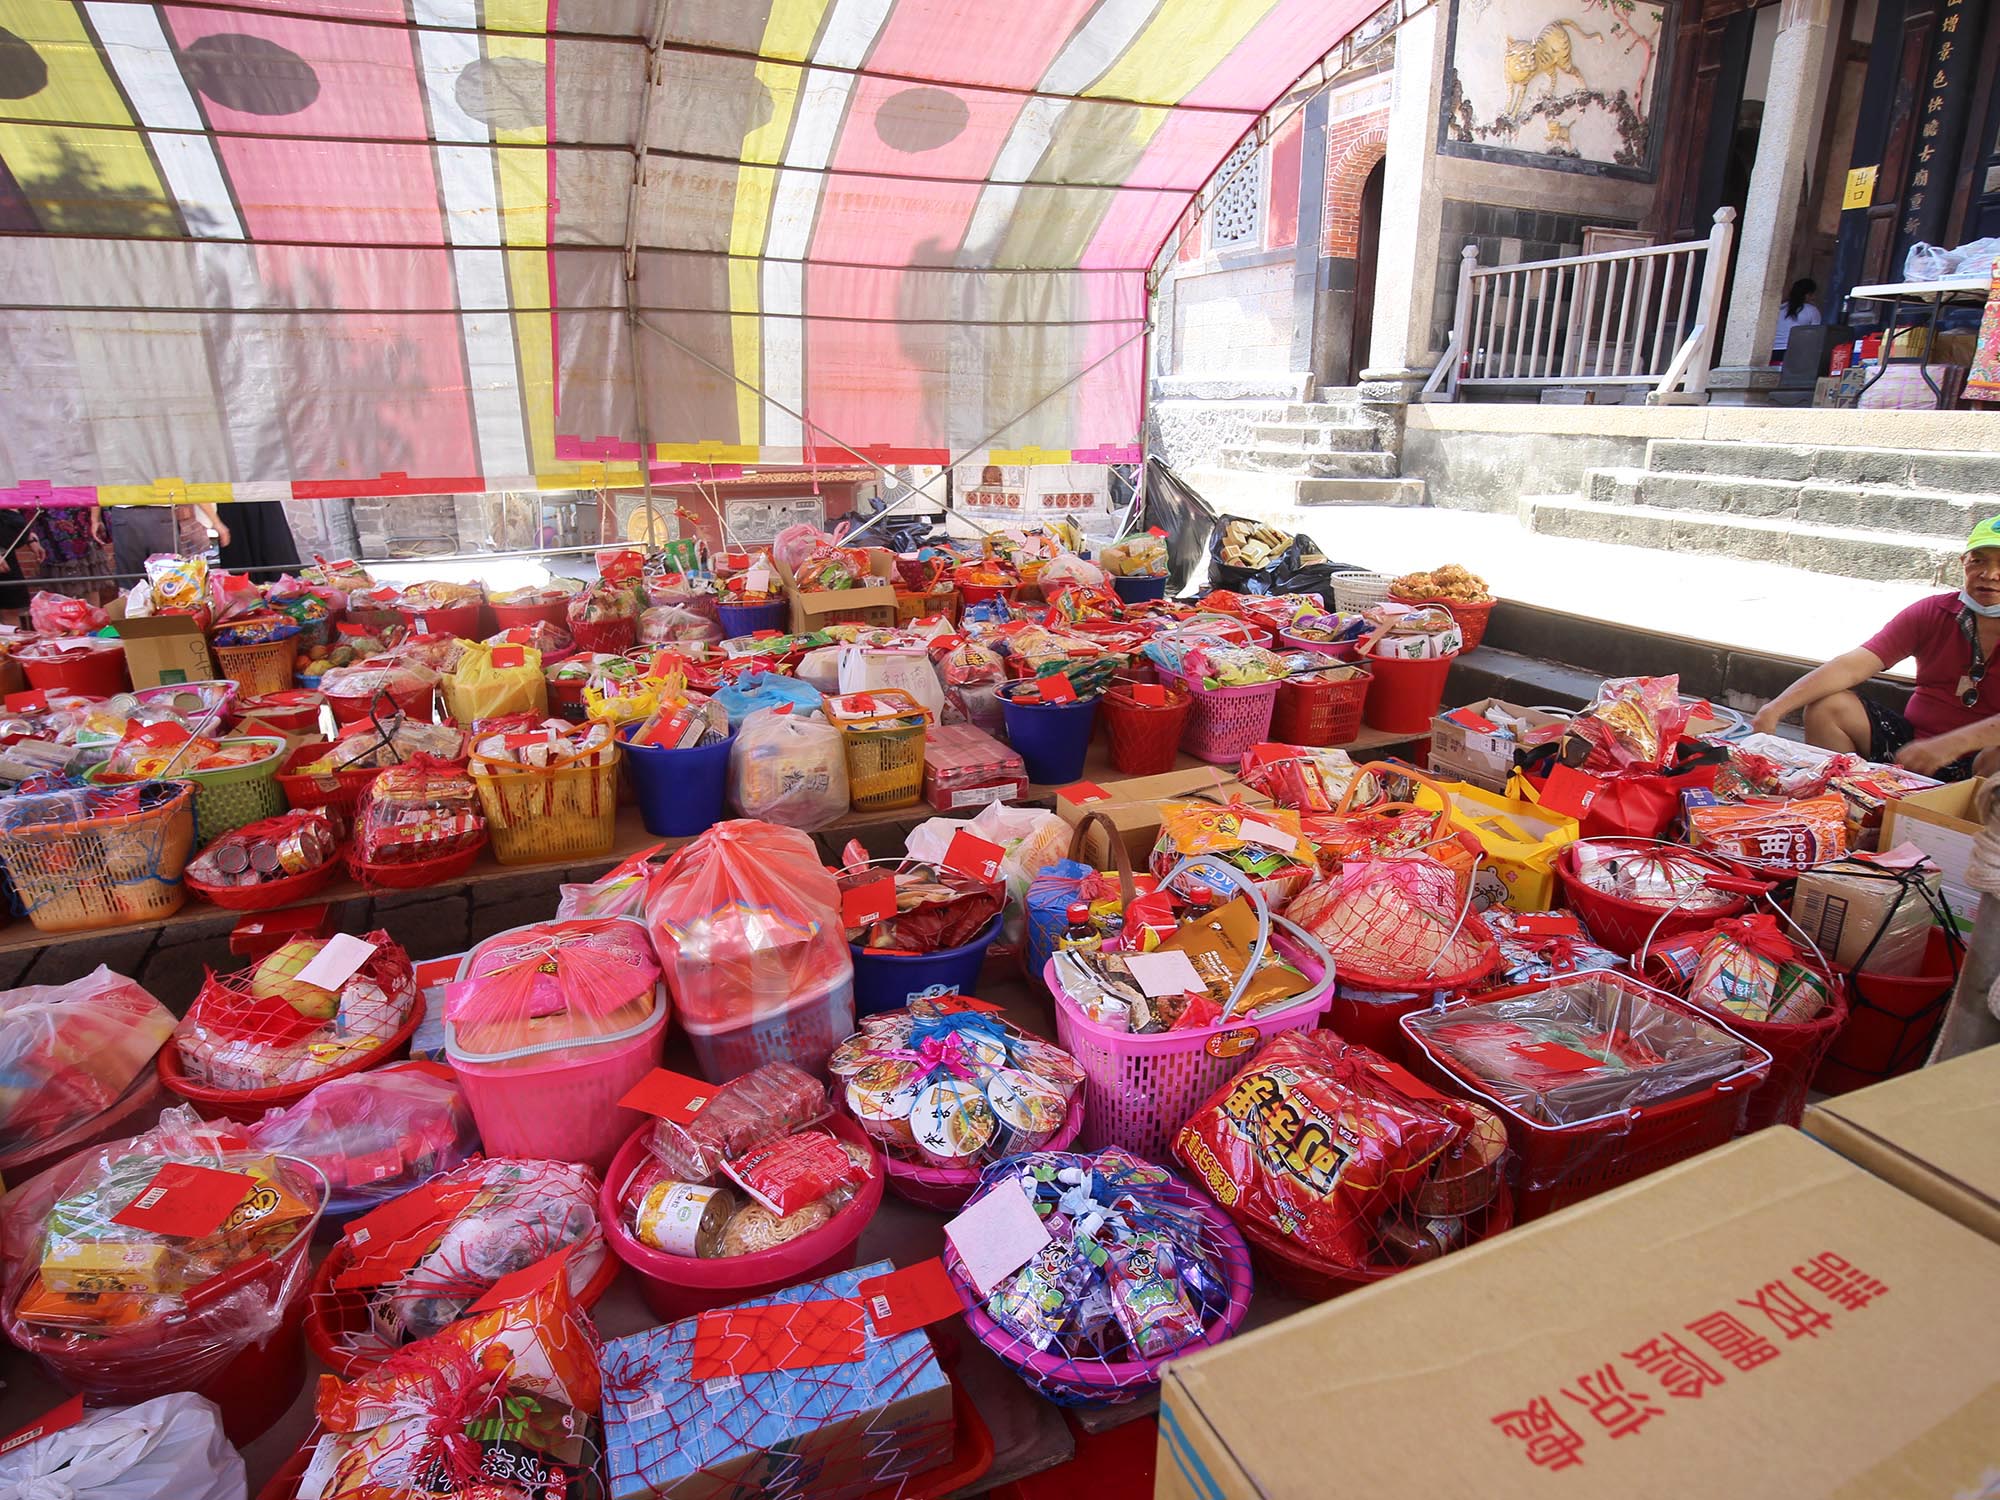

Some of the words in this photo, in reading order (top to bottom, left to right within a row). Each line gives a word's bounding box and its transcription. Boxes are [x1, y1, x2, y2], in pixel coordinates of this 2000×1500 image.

[1853, 171, 1867, 201] 出口
[1338, 1126, 1360, 1145] PEA
[1490, 1250, 1889, 1472] 請放置陰涼處
